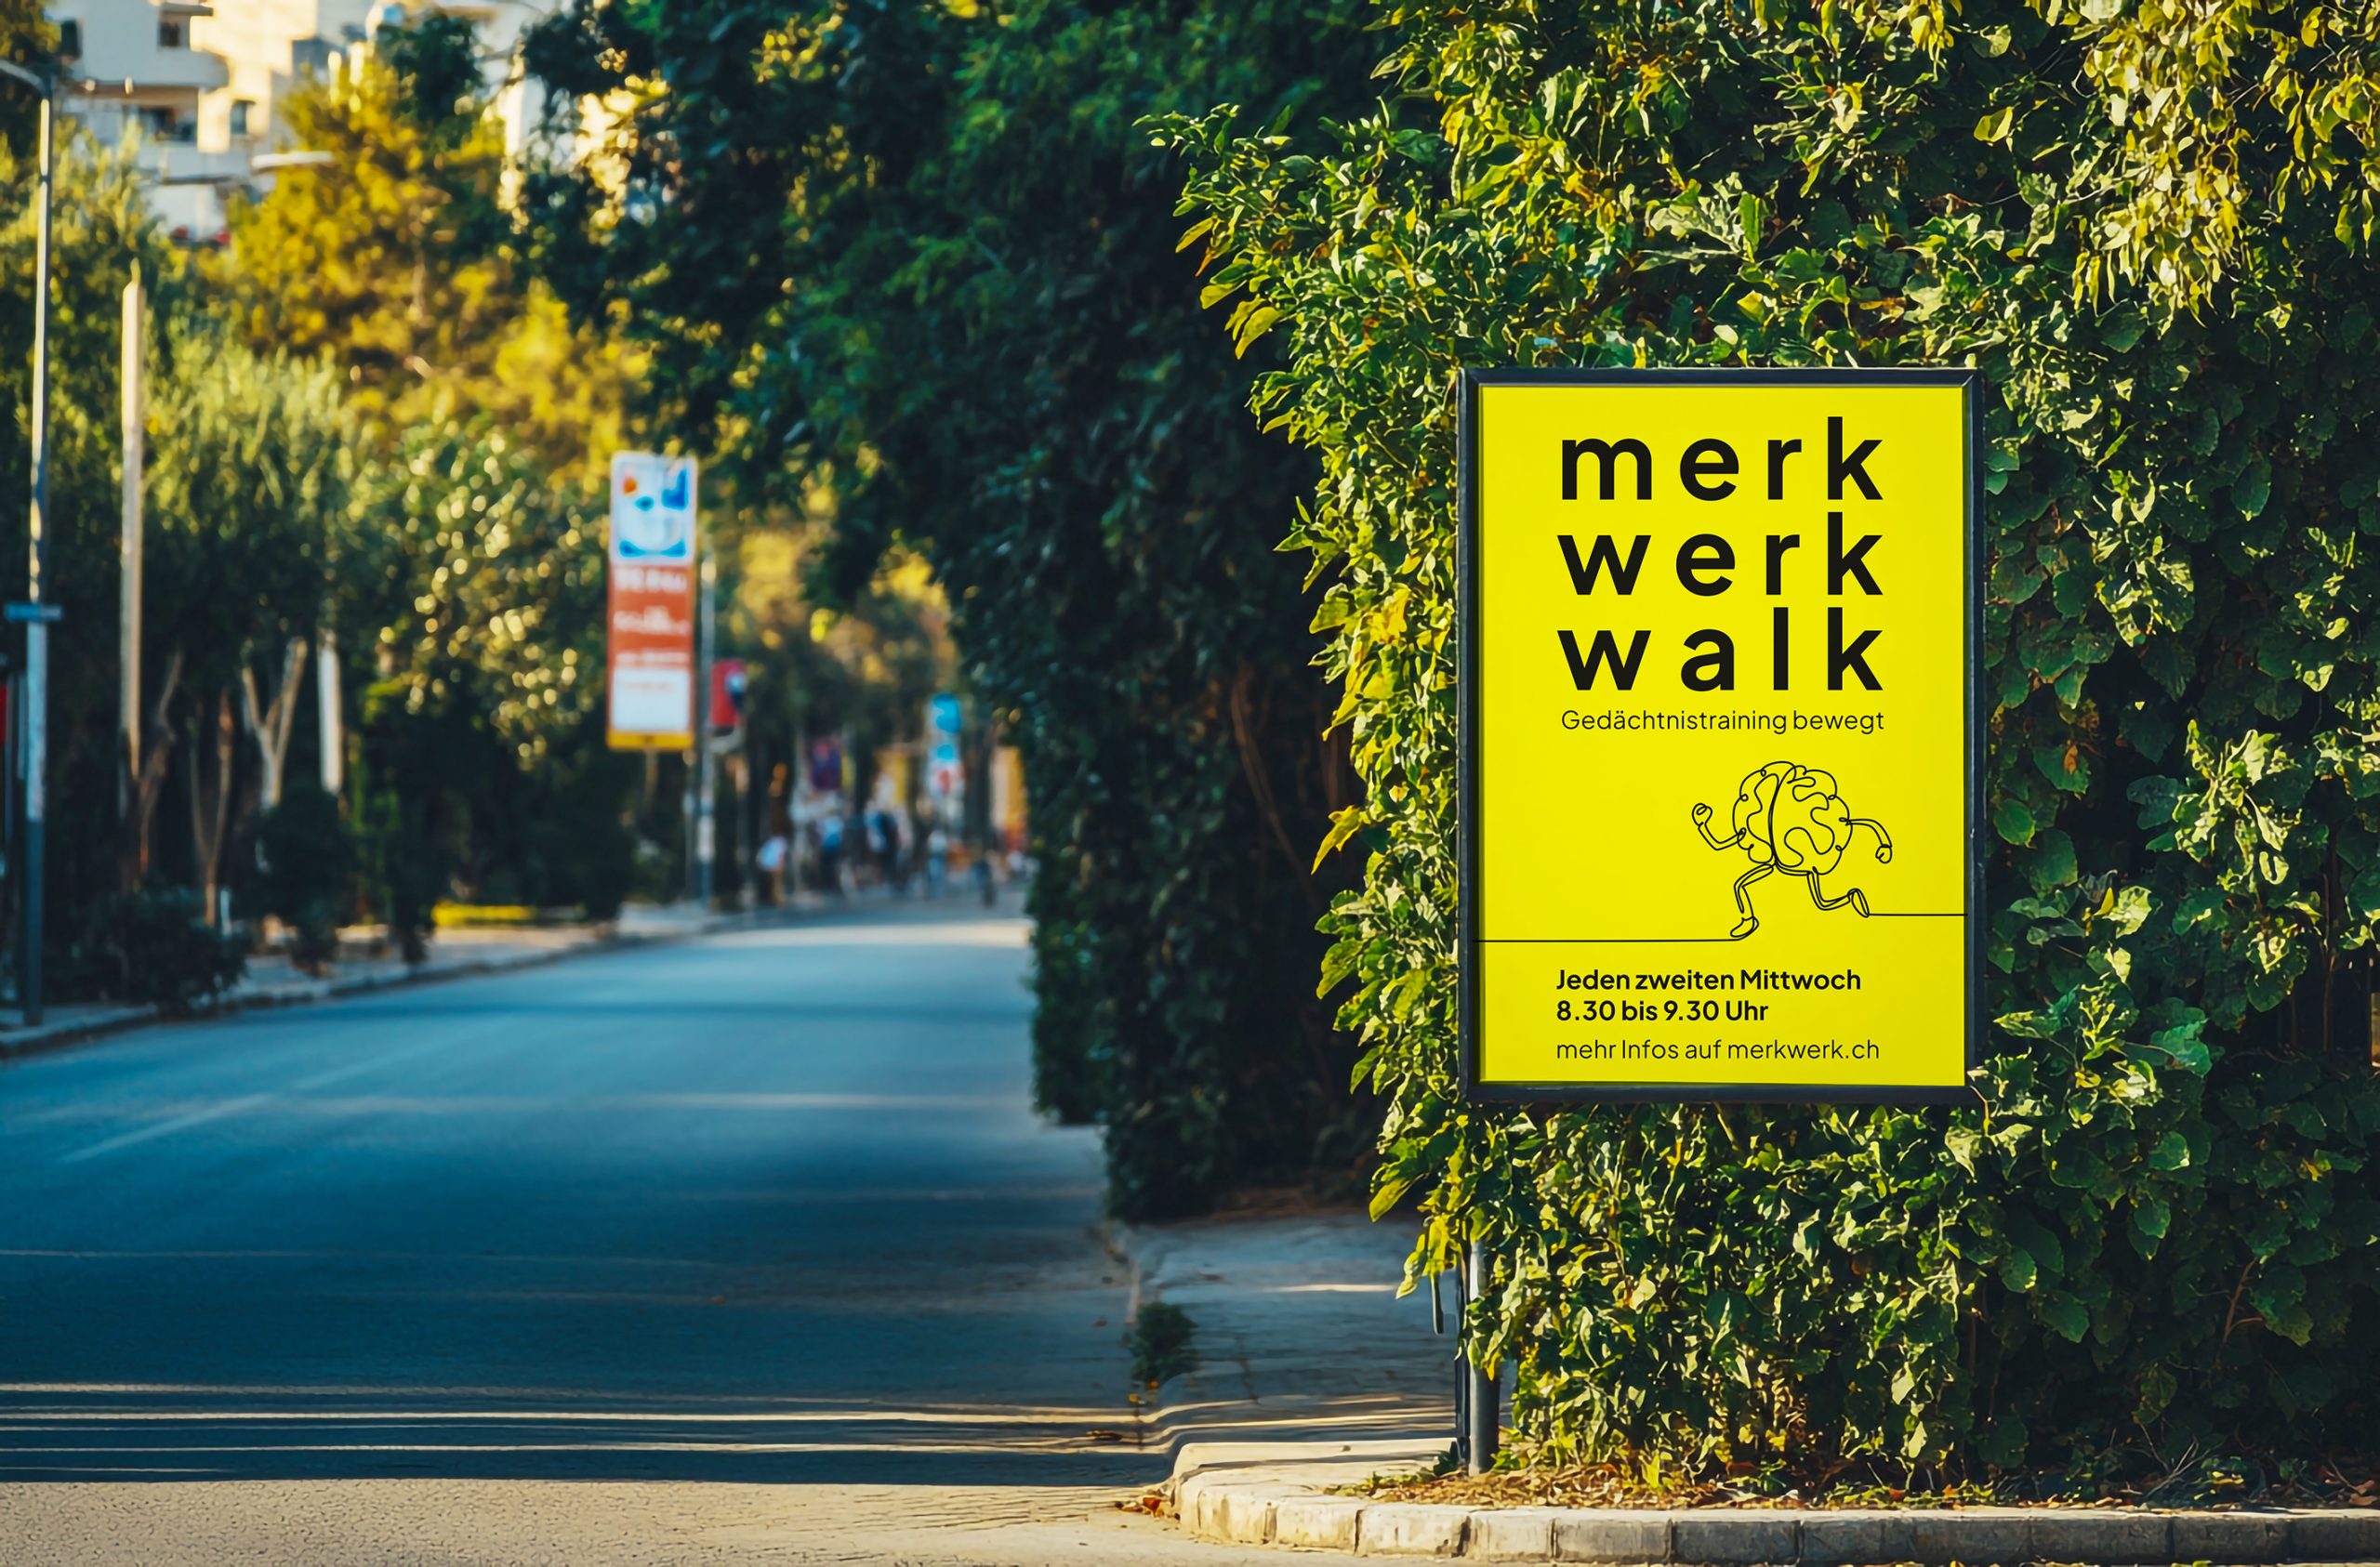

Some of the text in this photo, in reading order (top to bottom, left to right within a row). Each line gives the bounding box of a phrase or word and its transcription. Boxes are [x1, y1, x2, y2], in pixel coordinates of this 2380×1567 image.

[1562, 416, 1883, 501] merk
[1557, 512, 1883, 596] werk
[1557, 607, 1883, 691] walk
[1562, 710, 1884, 734] Gedächtnistraining bewegt
[1556, 969, 1861, 990] Jeden zweiten Mittwoch
[1556, 1000, 1768, 1021] 8.30 bis 9.30 Uhr
[1556, 1039, 1880, 1059] mehr Infos auf merkwerk.ch
